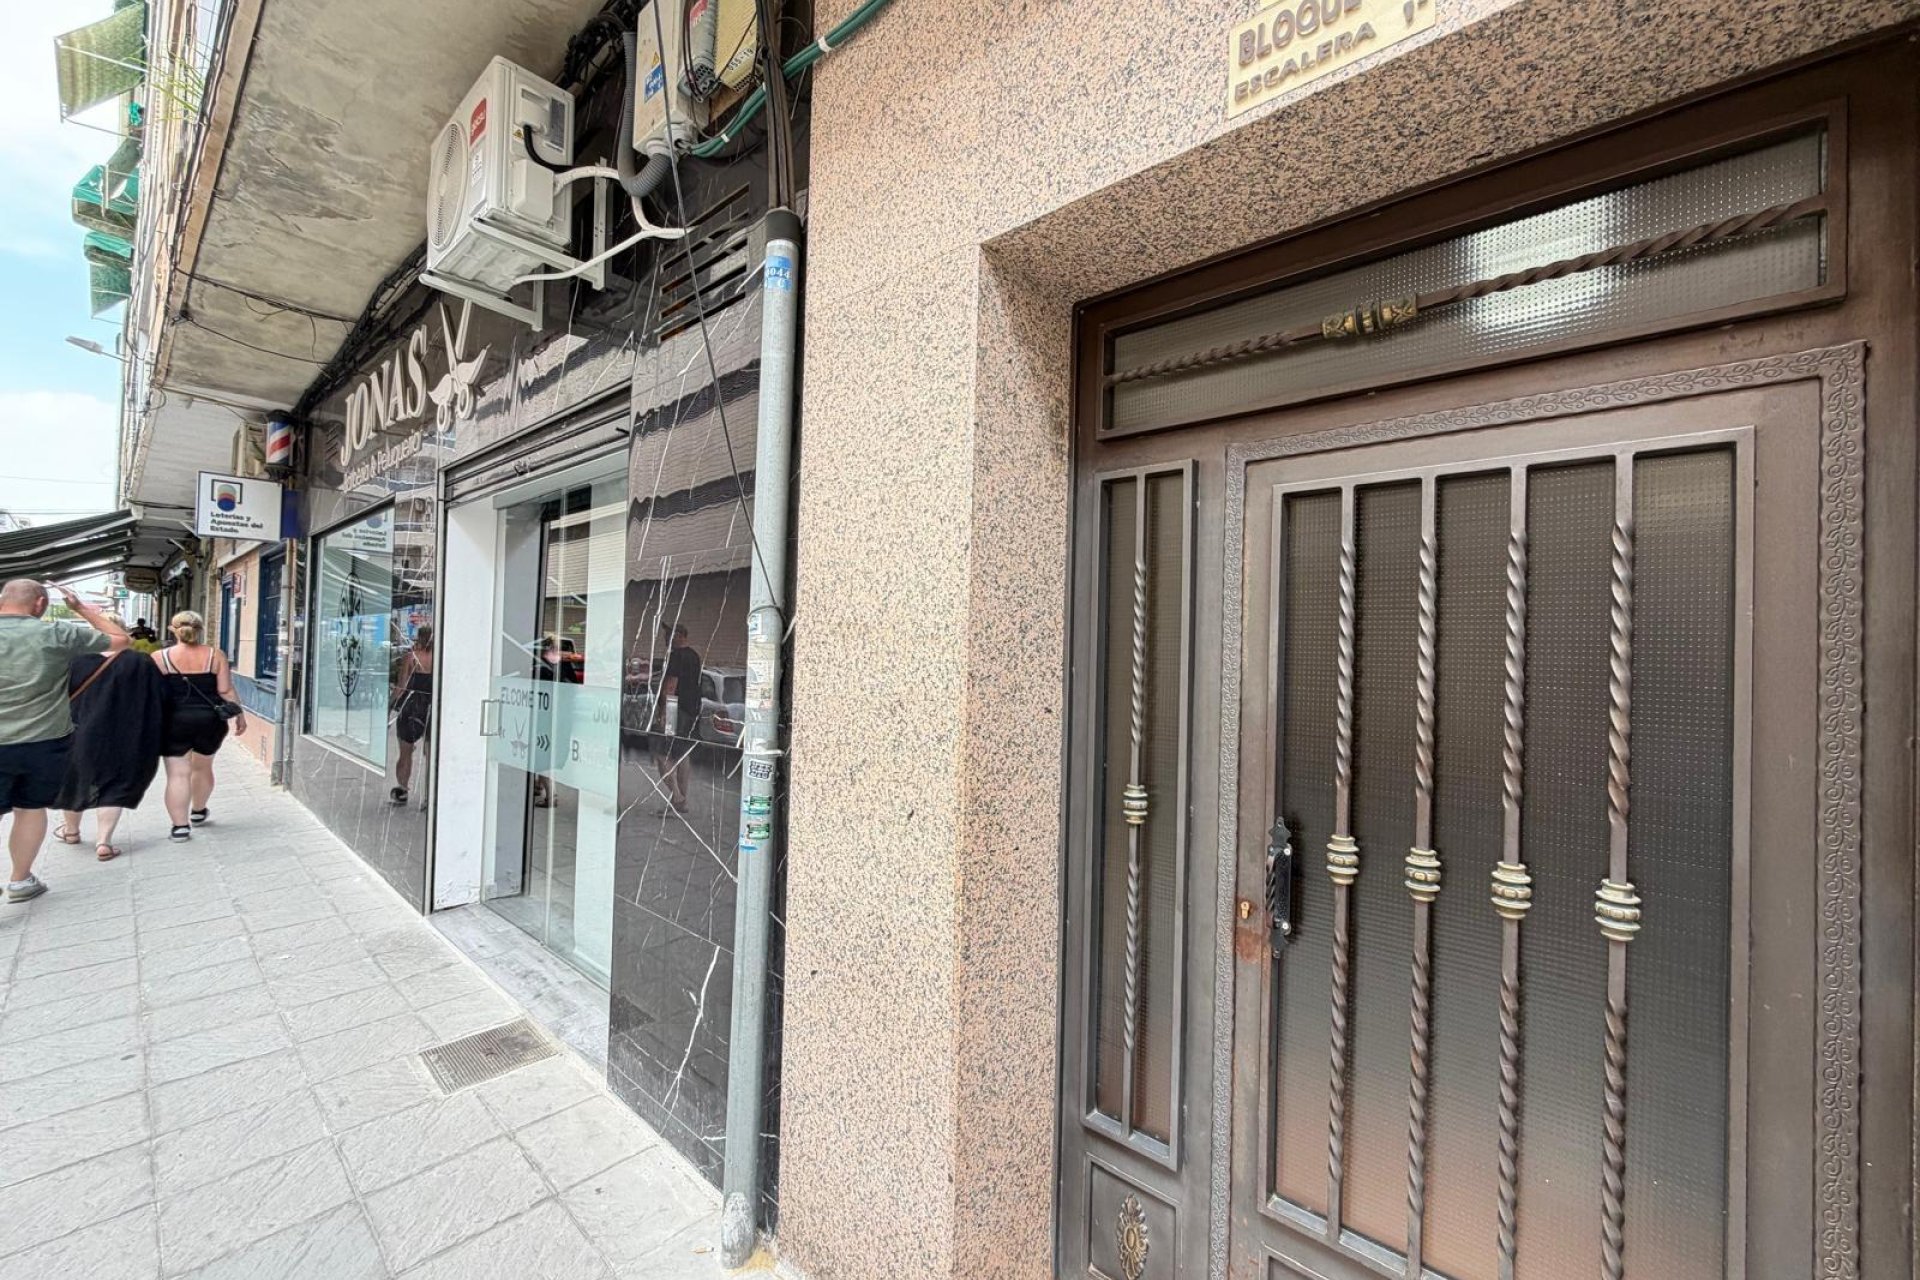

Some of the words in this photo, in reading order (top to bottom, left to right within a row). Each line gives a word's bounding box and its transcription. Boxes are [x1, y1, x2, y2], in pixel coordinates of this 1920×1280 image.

[1234, 21, 1377, 104] ESCALERA
[340, 324, 428, 467] JONAS
[500, 686, 534, 708] ELCOME
[538, 691, 550, 711] TO
